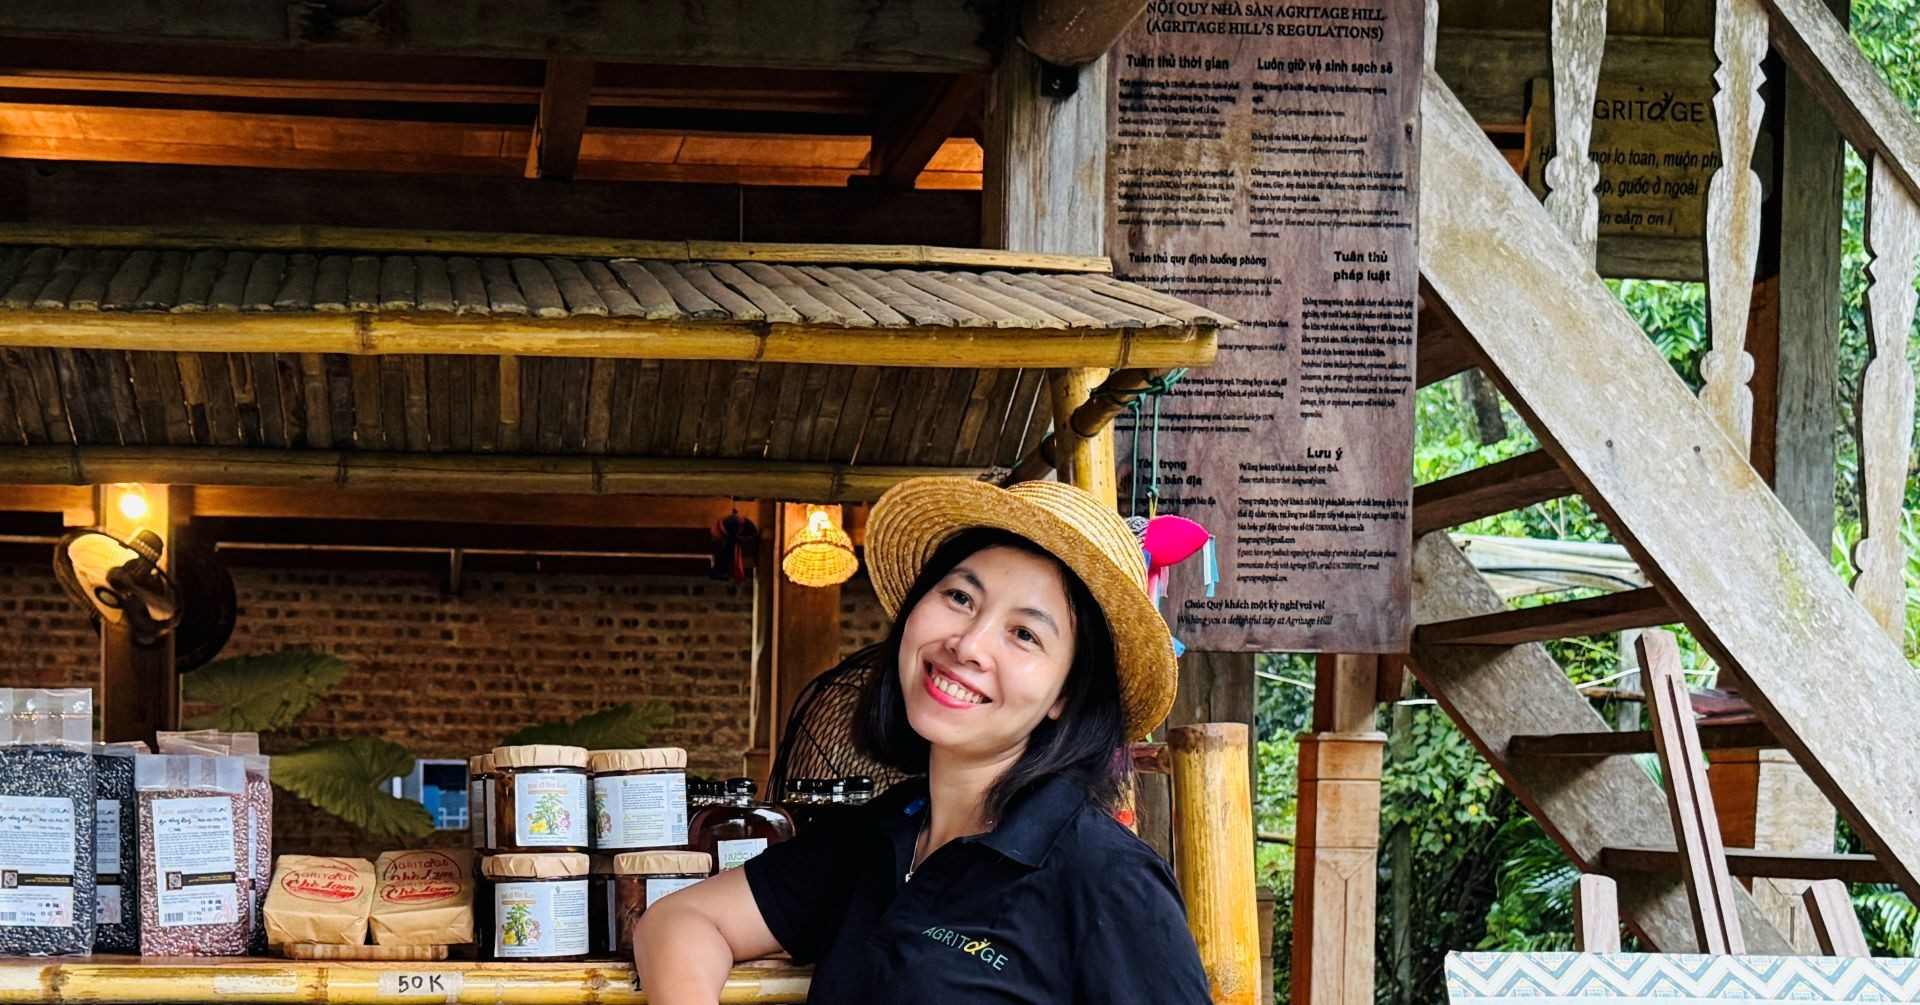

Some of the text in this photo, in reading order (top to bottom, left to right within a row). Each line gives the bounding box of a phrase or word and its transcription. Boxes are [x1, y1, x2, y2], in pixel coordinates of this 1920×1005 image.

[1147, 0, 1385, 21] NỘI QUY NHÀ SÀN AGRITAGE HILL
[1146, 18, 1226, 35] (AGRITAGE
[1277, 23, 1384, 42] REGULATIONS)
[1157, 53, 1176, 68] thủ
[1179, 55, 1201, 69] thời
[1204, 56, 1229, 71] gian
[1257, 57, 1284, 71] Luôn
[1309, 60, 1322, 75] vệ
[1325, 60, 1348, 73] sinh
[1351, 61, 1377, 76] sạch
[1594, 92, 1704, 122] GRITAGE
[1613, 149, 1625, 164] lo
[1629, 150, 1659, 168] toan,
[1618, 176, 1649, 197] guốc
[1153, 252, 1168, 264] thủ
[1170, 255, 1187, 267] quy
[1188, 254, 1208, 267] định
[1239, 254, 1267, 268] phòng
[1334, 250, 1388, 263] Tuân thủ
[1333, 269, 1391, 284] pháp luật
[1307, 447, 1344, 461] Lưu ý
[1159, 459, 1187, 472] trọng
[1164, 474, 1183, 485] bản
[1185, 475, 1202, 488] địa
[1184, 599, 1206, 610] Chúc
[1206, 600, 1224, 612] Quý
[1224, 599, 1250, 610] khách
[1250, 601, 1268, 612] một
[1262, 616, 1276, 627] stay
[1276, 617, 1285, 625] at
[1285, 616, 1315, 628] Agritage
